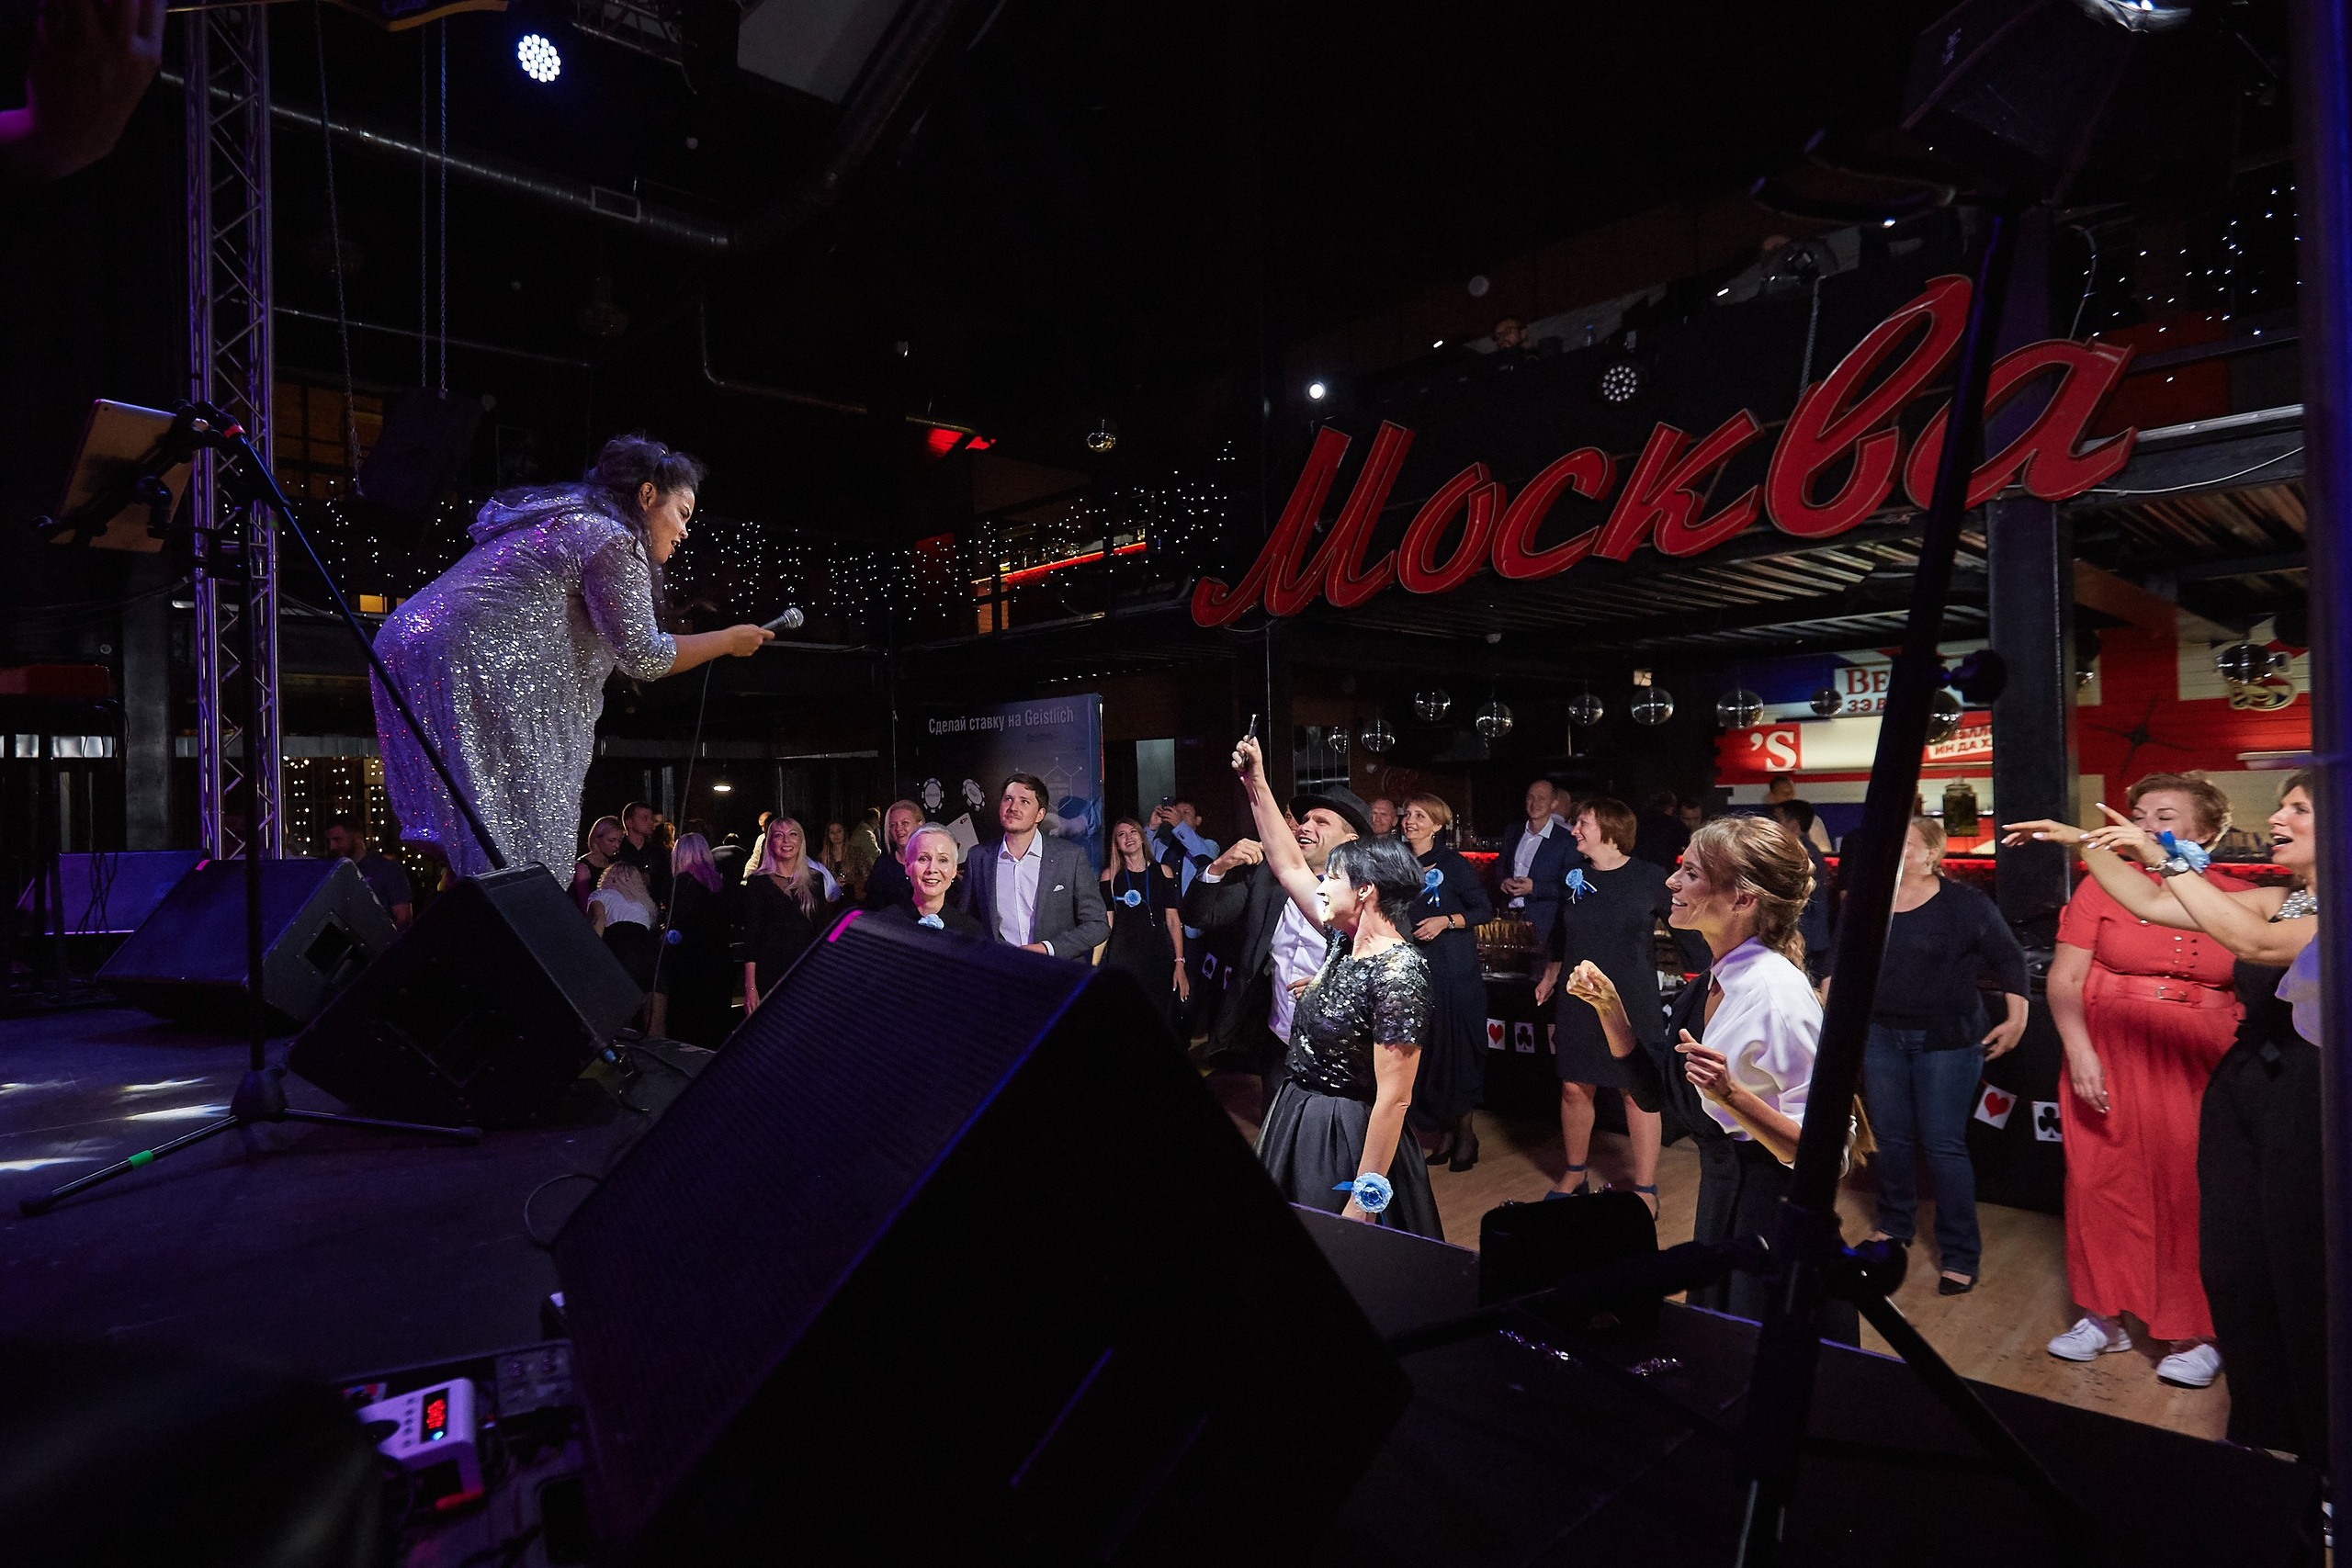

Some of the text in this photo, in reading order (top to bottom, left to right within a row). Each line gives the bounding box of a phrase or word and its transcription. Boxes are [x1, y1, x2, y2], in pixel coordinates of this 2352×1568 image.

[1193, 273, 2138, 628] Москва
[1846, 669, 1889, 695] ВЕ
[928, 705, 1074, 735] Сделай ставку на Geistlich
